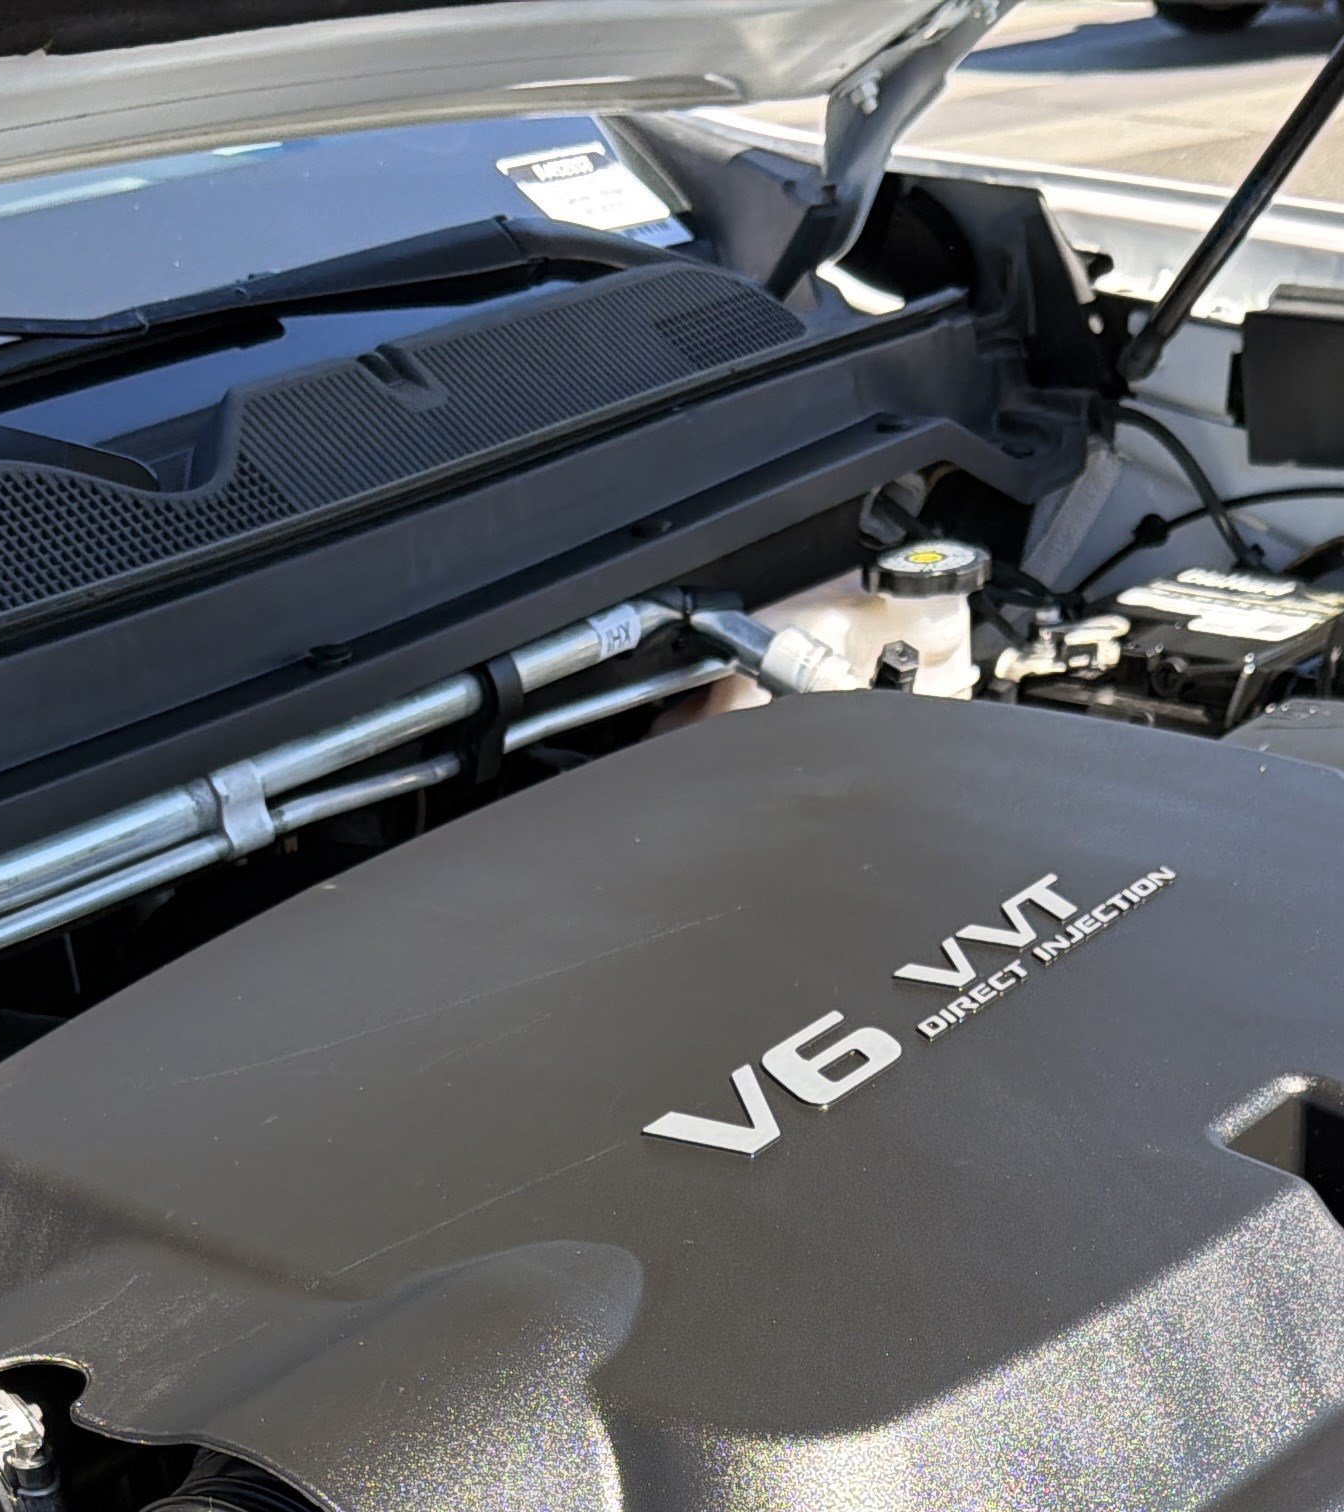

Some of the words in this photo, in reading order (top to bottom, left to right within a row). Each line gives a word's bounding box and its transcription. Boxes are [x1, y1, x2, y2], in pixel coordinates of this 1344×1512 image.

[893, 873, 1078, 988] VVT
[916, 959, 1029, 1041] DIRECT
[1032, 866, 1176, 965] INJECTION
[642, 1010, 902, 1155] V6
